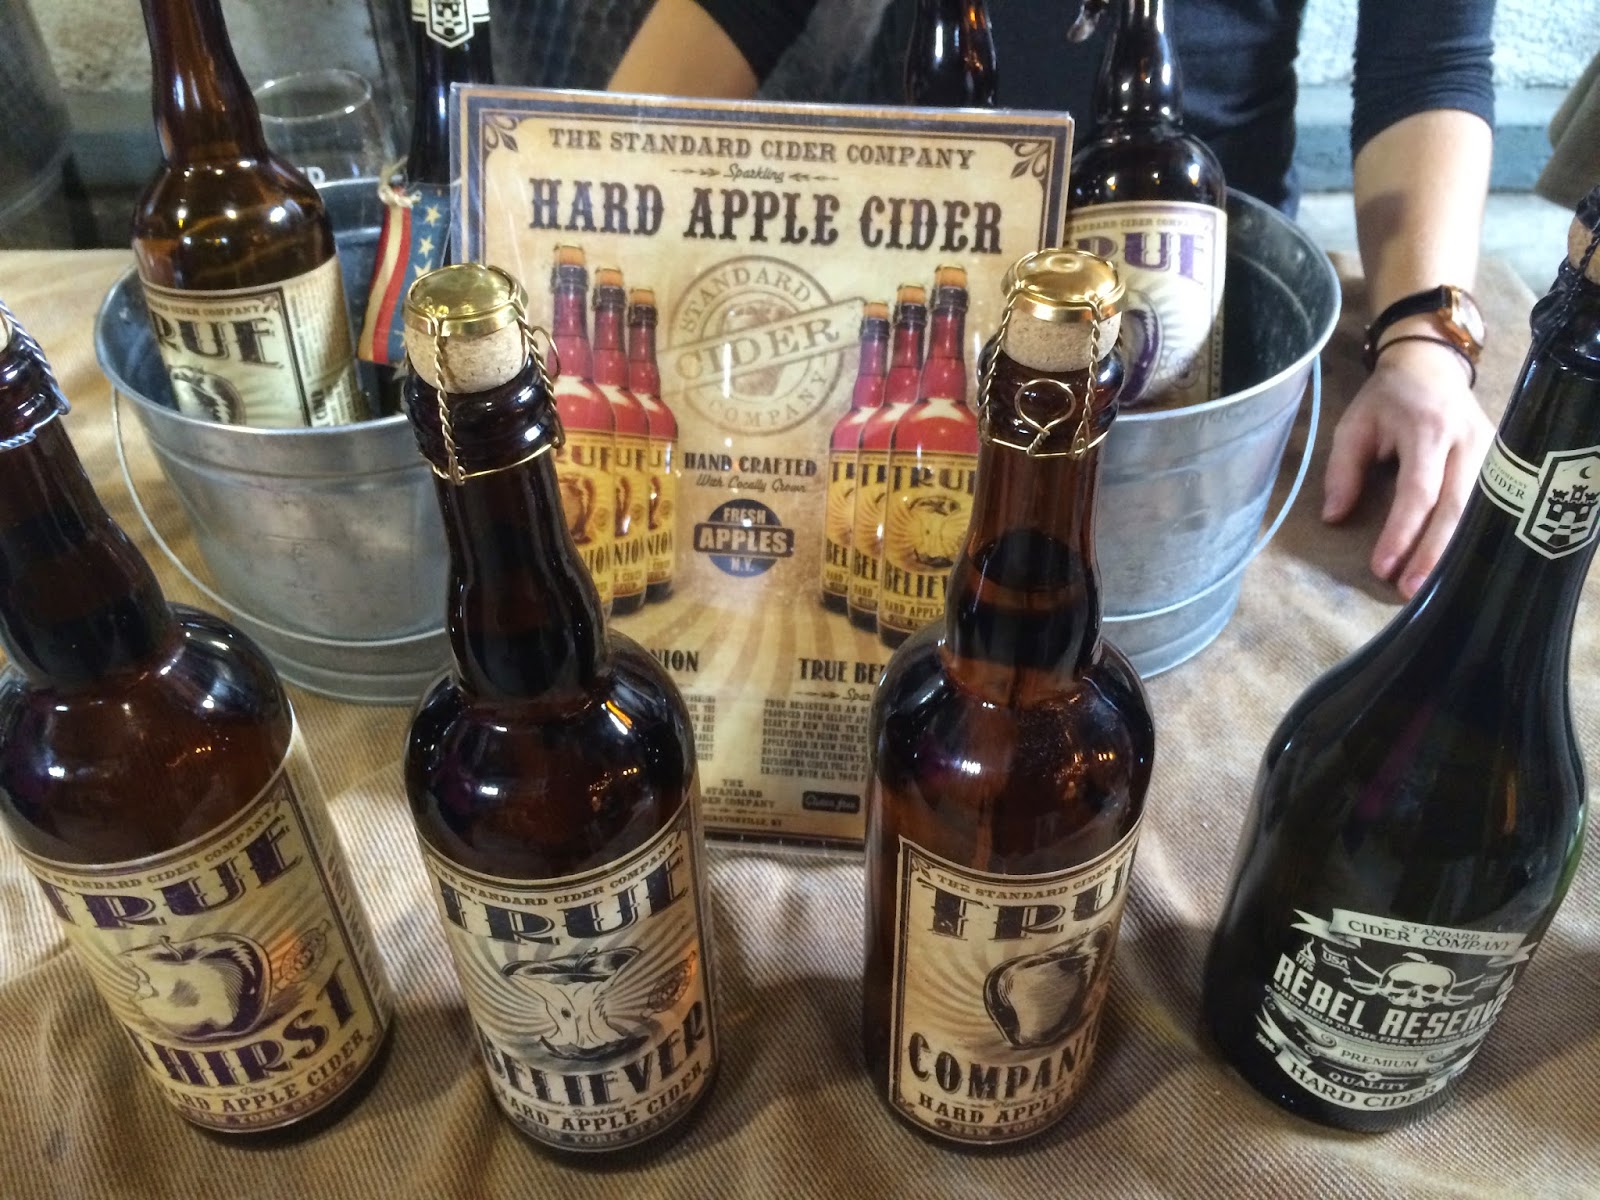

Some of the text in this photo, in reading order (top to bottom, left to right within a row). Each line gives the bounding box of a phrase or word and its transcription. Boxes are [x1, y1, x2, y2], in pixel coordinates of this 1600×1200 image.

[549, 128, 976, 170] THE STANDARD CIDER COMPANY
[724, 163, 785, 184] Sparkling
[529, 178, 1003, 255] HARD APPLE CIDER
[679, 266, 812, 335] STANDARD
[150, 310, 285, 370] RUE
[675, 317, 840, 381] CIDER
[709, 370, 829, 428] COMPANY
[684, 452, 733, 472] HAND
[739, 455, 818, 477] CRAFTED
[1489, 467, 1525, 500] CIDER
[723, 507, 767, 525] FRESH
[699, 527, 788, 554] APPLES
[798, 658, 848, 683] TRUE
[705, 787, 763, 799] STANDARD
[721, 778, 744, 788] THE
[701, 796, 776, 809] DER COMPANY
[53, 807, 273, 890] STANDARD CIDER COMPANY
[460, 883, 549, 907] STANDARD
[553, 885, 605, 905] CIDER
[610, 839, 675, 890] COMPANY
[937, 873, 970, 895] THE
[975, 886, 1069, 901] STANDARD
[1072, 863, 1113, 889] CIDER
[917, 857, 1129, 942] TRU
[1347, 919, 1514, 952] CIDER COMPANY
[1401, 923, 1482, 942] STANDARD
[1322, 949, 1350, 970] USA
[1272, 952, 1366, 1031] REBEL
[167, 1086, 212, 1112] ARD
[221, 1082, 301, 1113] APPLE
[306, 1030, 366, 1085] CIDER
[1341, 1049, 1419, 1069] PREMIUM
[1289, 1062, 1438, 1108] HARD CIDER
[1328, 1071, 1409, 1092] QUALITY
[561, 1109, 639, 1133] APPLE
[649, 1066, 707, 1115] CIDER
[918, 1093, 985, 1124] HARD
